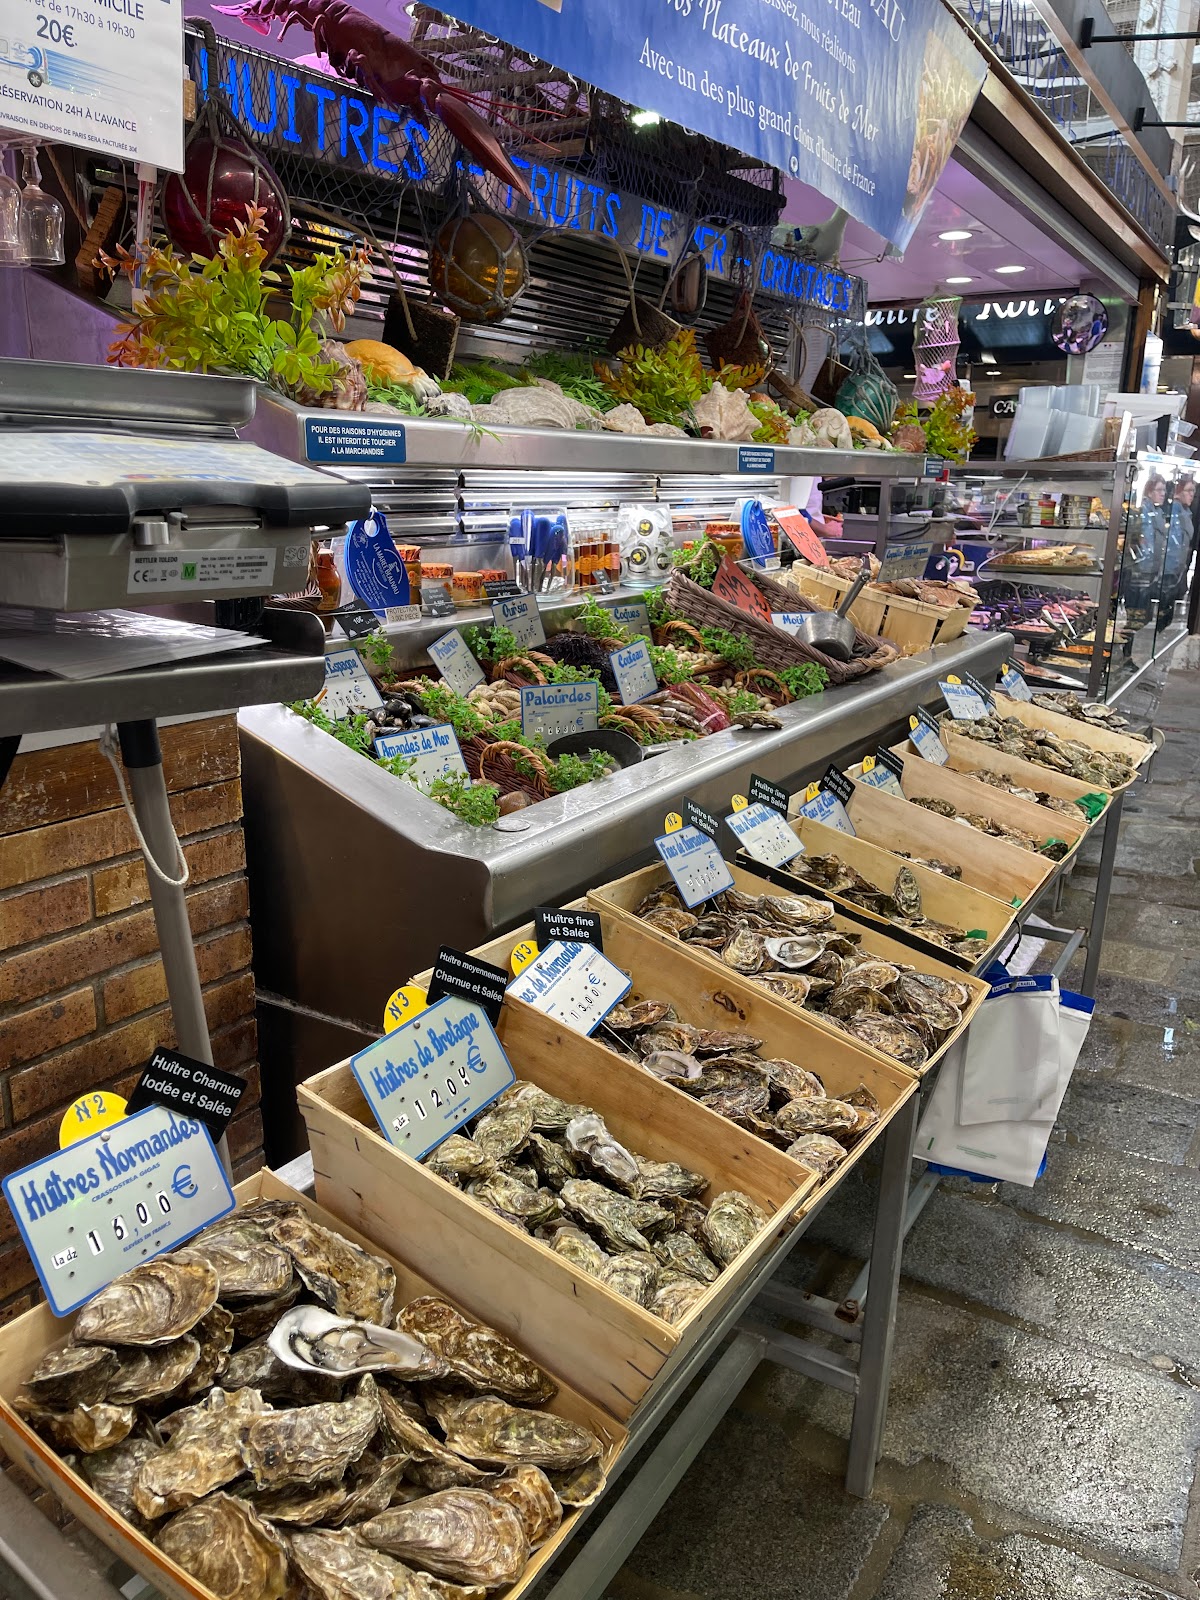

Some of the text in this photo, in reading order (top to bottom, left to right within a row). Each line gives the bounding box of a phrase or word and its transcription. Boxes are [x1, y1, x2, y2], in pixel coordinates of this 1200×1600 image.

[48, 1, 62, 14] de
[65, 5, 96, 25] 17h30
[97, 16, 104, 28] à
[106, 20, 136, 39] 19h30
[870, 0, 906, 43] AU
[801, 12, 820, 42] nous
[821, 30, 857, 74] réalisons
[699, 0, 782, 69] Plateaux
[784, 41, 800, 81] de
[802, 60, 836, 113] Fruits
[838, 88, 850, 125] de
[851, 104, 880, 142] Mer
[30, 118, 39, 128] EN
[39, 121, 63, 133] DEHORS
[63, 127, 72, 137] DE
[72, 130, 87, 141] PARIS
[87, 134, 102, 144] SERA
[65, 103, 84, 118] 24H
[85, 107, 94, 121] À
[94, 112, 138, 133] L'AVANCE
[638, 37, 675, 80] Avec
[677, 65, 698, 92] un
[700, 71, 724, 104] des
[726, 85, 756, 117] plus
[758, 104, 792, 138] grand
[793, 119, 815, 153] choix
[842, 157, 852, 178] de
[851, 164, 877, 197] France
[201, 47, 430, 182] HUITRES
[637, 203, 674, 257] DE
[693, 224, 729, 275] ER
[310, 425, 402, 438] POUR DES RAISONS D'HYGIENNES
[317, 436, 397, 447] IL EST INTERDIT DE TOUCHER
[331, 446, 336, 454] A
[344, 447, 385, 456] MARCHANDISE
[134, 556, 158, 564] METTLER
[386, 605, 418, 614] PROTECTION
[613, 607, 641, 622] Coques
[525, 687, 592, 707] Palourdes
[380, 736, 420, 759] Amandes
[421, 732, 433, 751] de
[432, 730, 450, 748] Mer
[750, 788, 759, 797] et
[758, 791, 770, 802] pas
[687, 802, 707, 820] Huître
[690, 815, 698, 824] et
[542, 912, 595, 928] Huître fine
[549, 926, 590, 939] et Salée
[439, 950, 508, 986] Huître moyennement
[435, 968, 503, 1003] Charnue et Salée
[525, 974, 549, 993] de
[413, 1039, 435, 1069] de
[426, 1012, 480, 1058] Bretagne
[466, 1045, 488, 1074] €
[151, 1054, 242, 1098] Huître Charnue
[141, 1073, 233, 1118] Iodée et Salée
[95, 1110, 201, 1182] Normandes
[91, 1161, 161, 1204] CRASSOSTREA GIGAS
[171, 1164, 200, 1199] €
[151, 1220, 172, 1235] FRANCE
